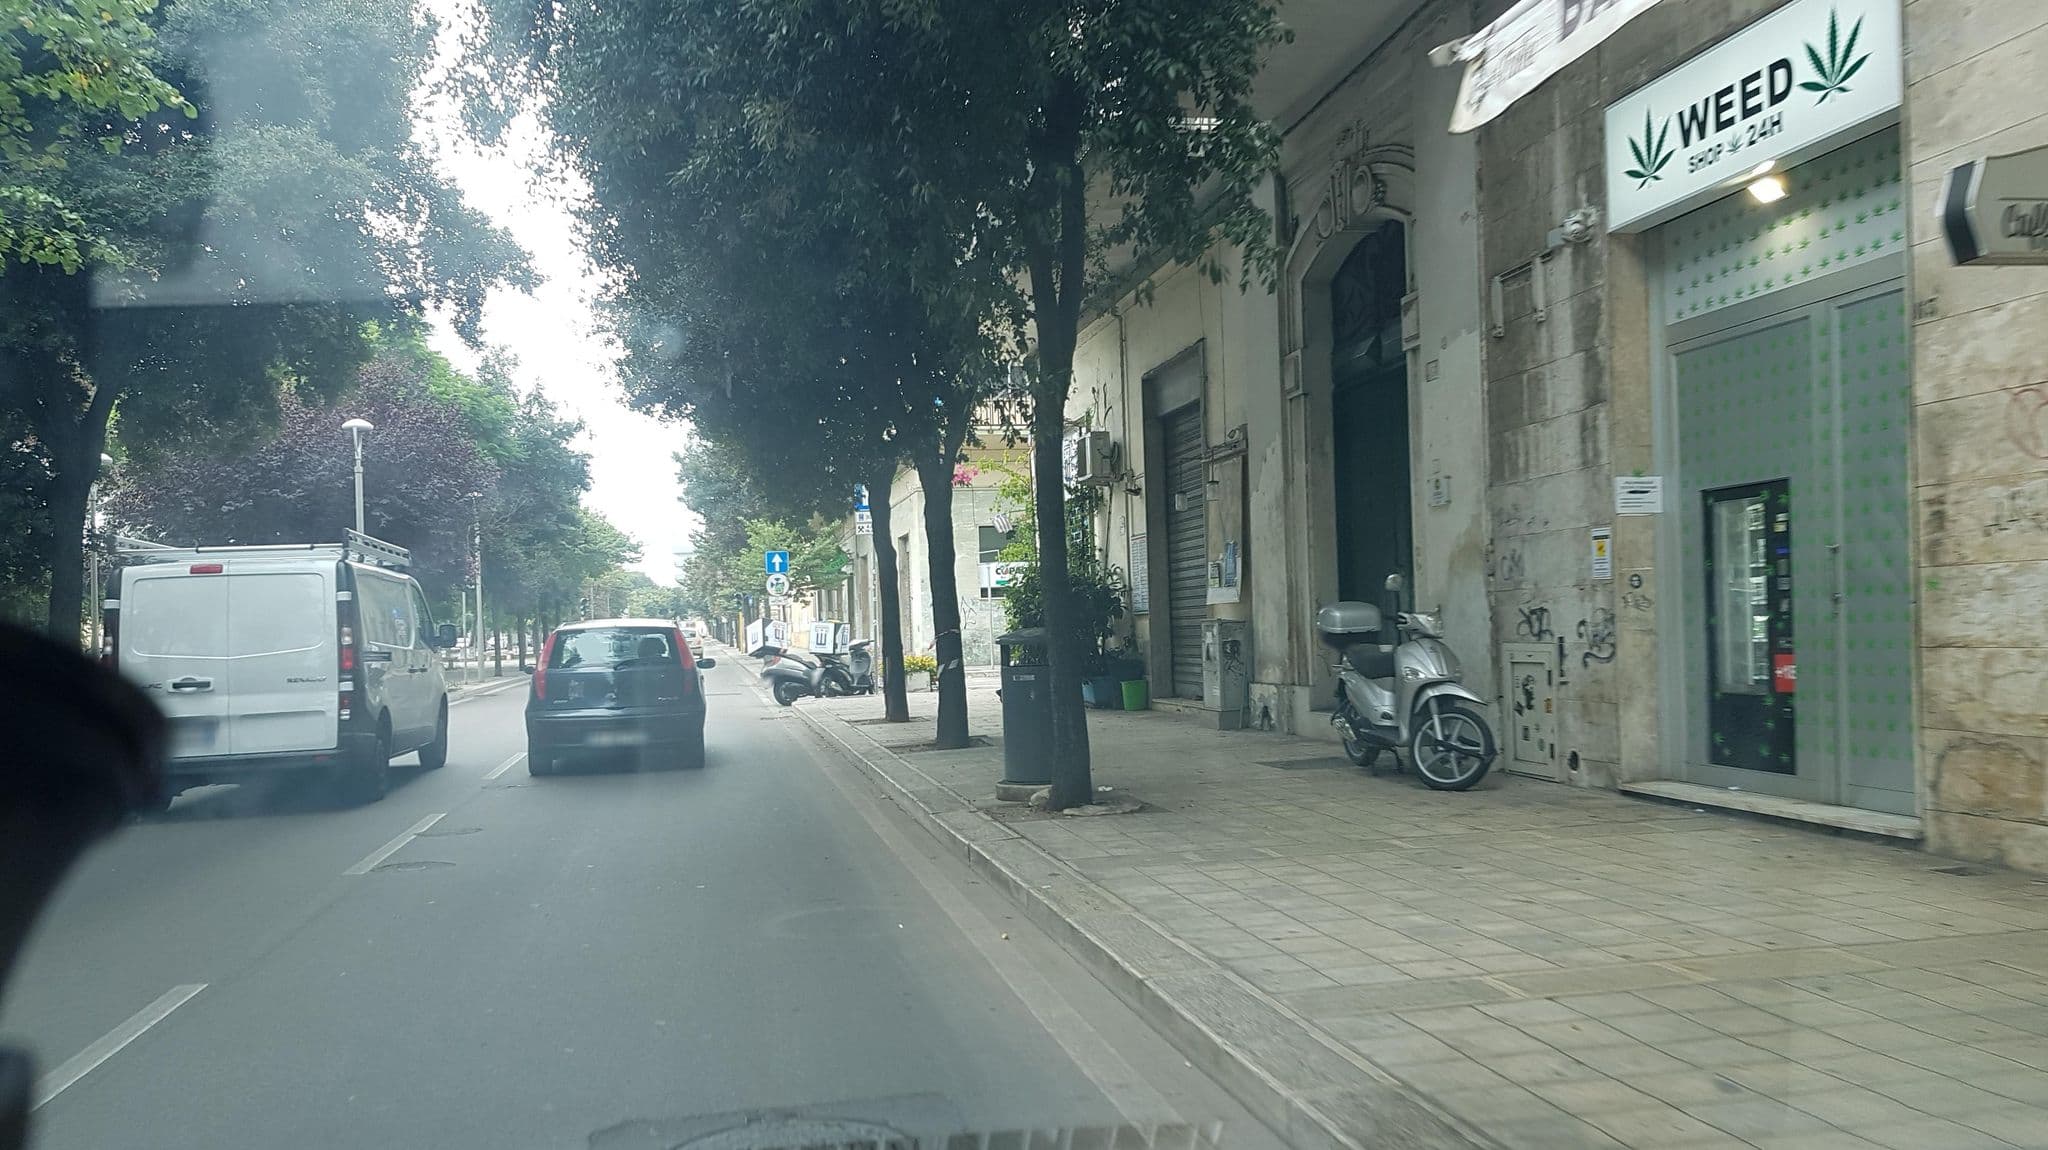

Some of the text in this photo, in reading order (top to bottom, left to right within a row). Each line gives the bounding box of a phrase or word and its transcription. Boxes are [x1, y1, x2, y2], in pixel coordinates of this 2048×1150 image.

[1678, 57, 1793, 149] WEED
[1688, 110, 1784, 174] SHOP 24H
